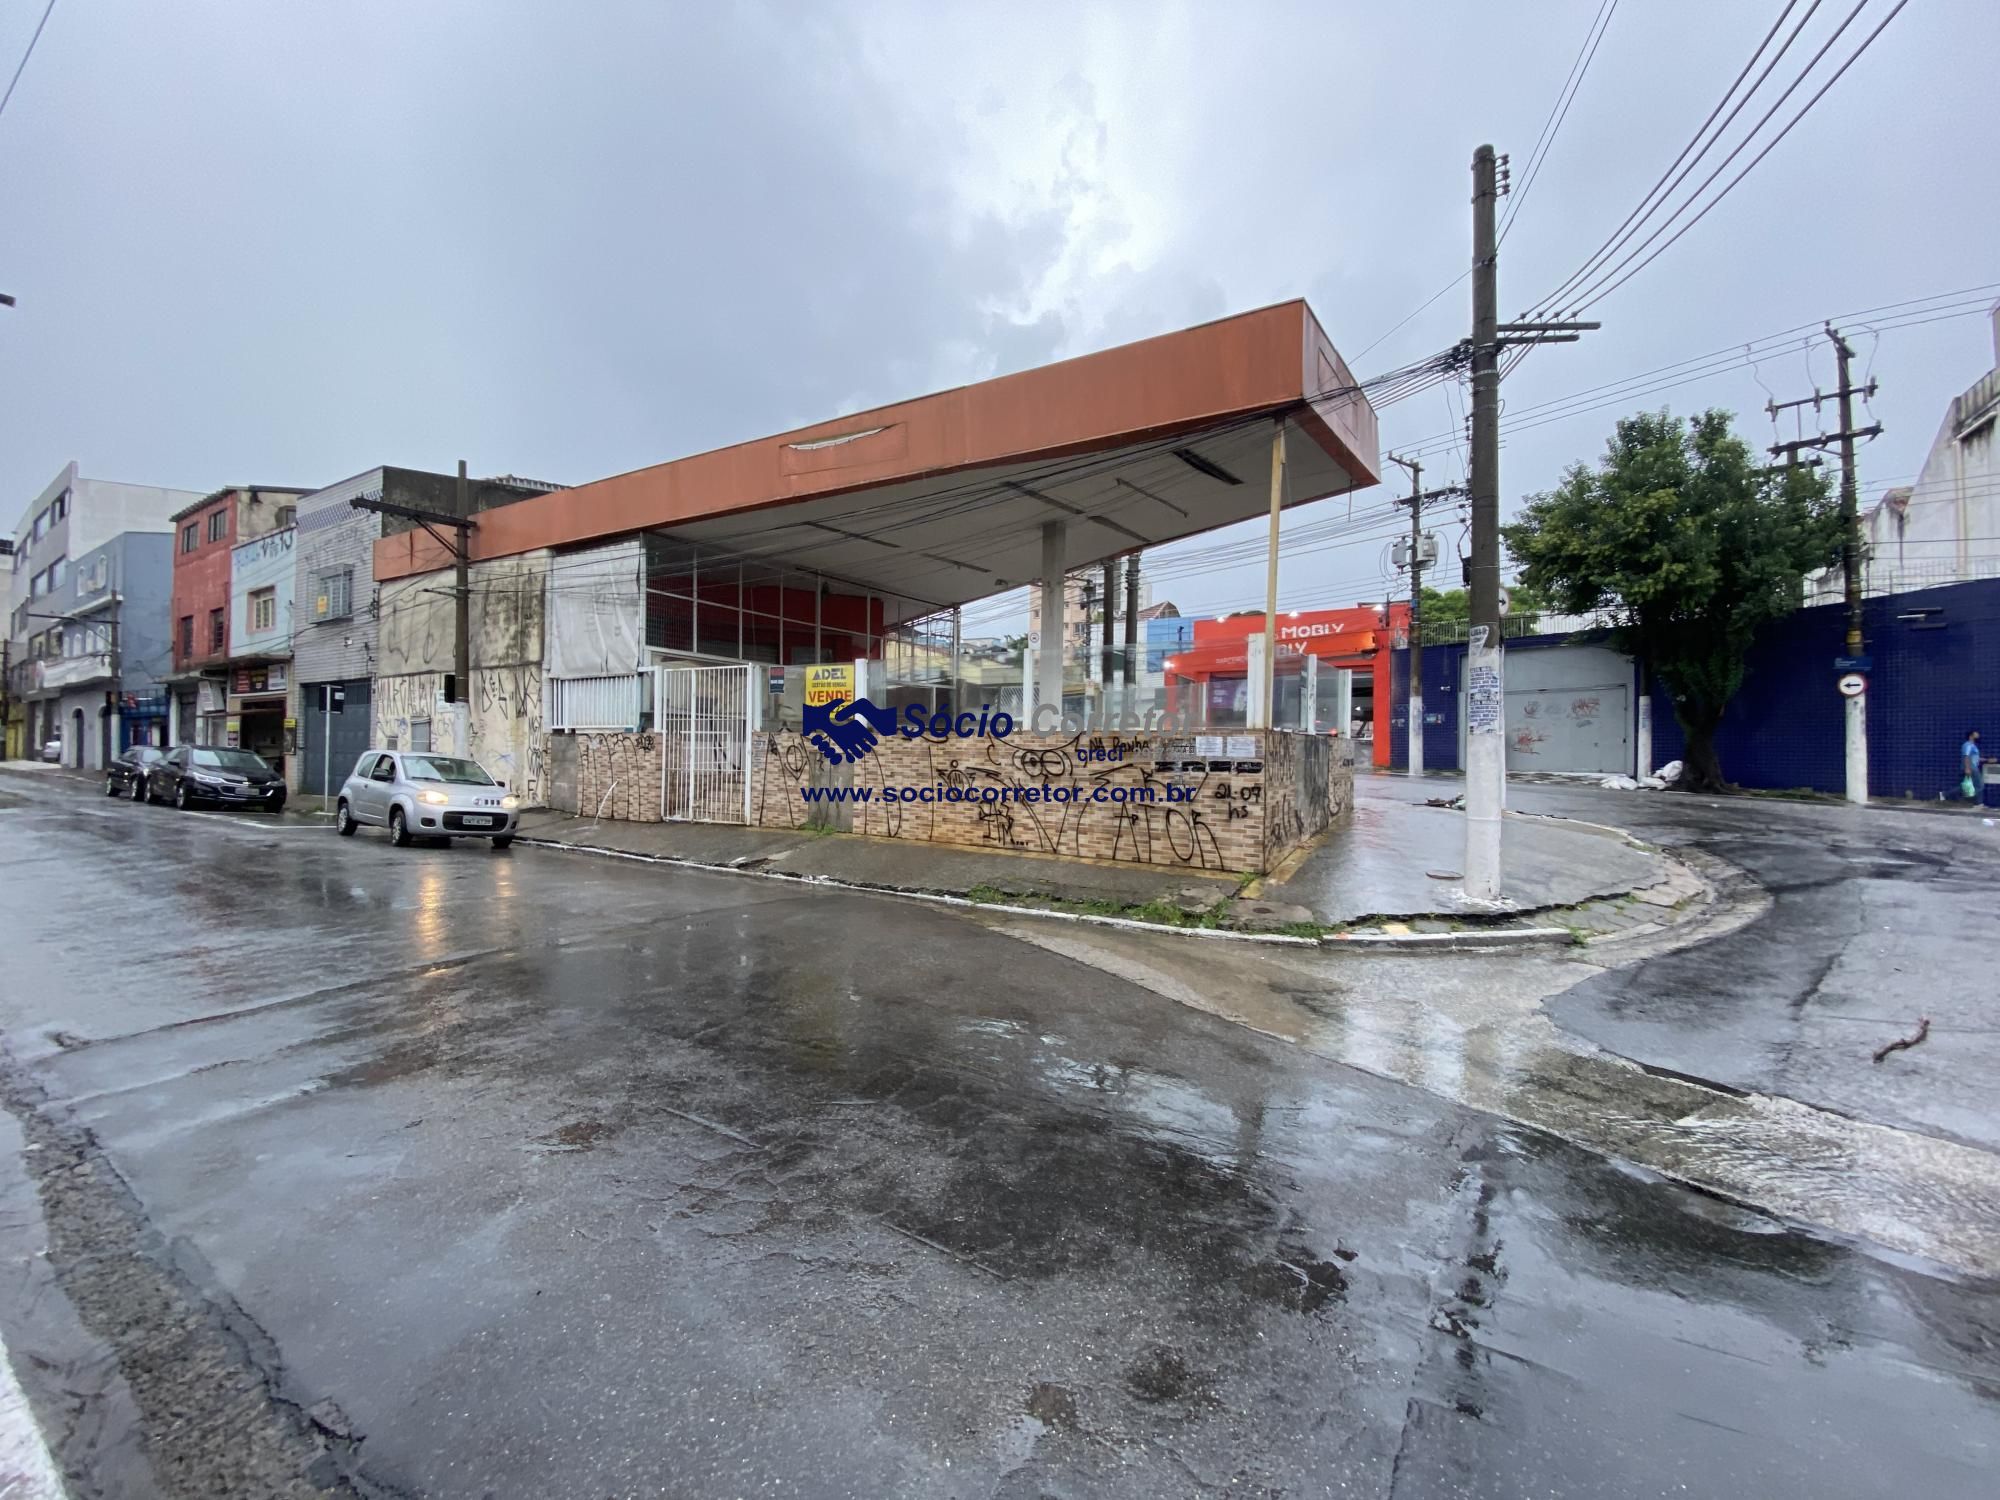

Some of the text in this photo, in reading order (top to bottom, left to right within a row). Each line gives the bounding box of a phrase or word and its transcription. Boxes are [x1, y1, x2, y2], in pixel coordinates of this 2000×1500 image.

[1281, 624, 1346, 639] MOBLY
[812, 667, 847, 681] ADEL
[808, 690, 853, 702] VENDE
